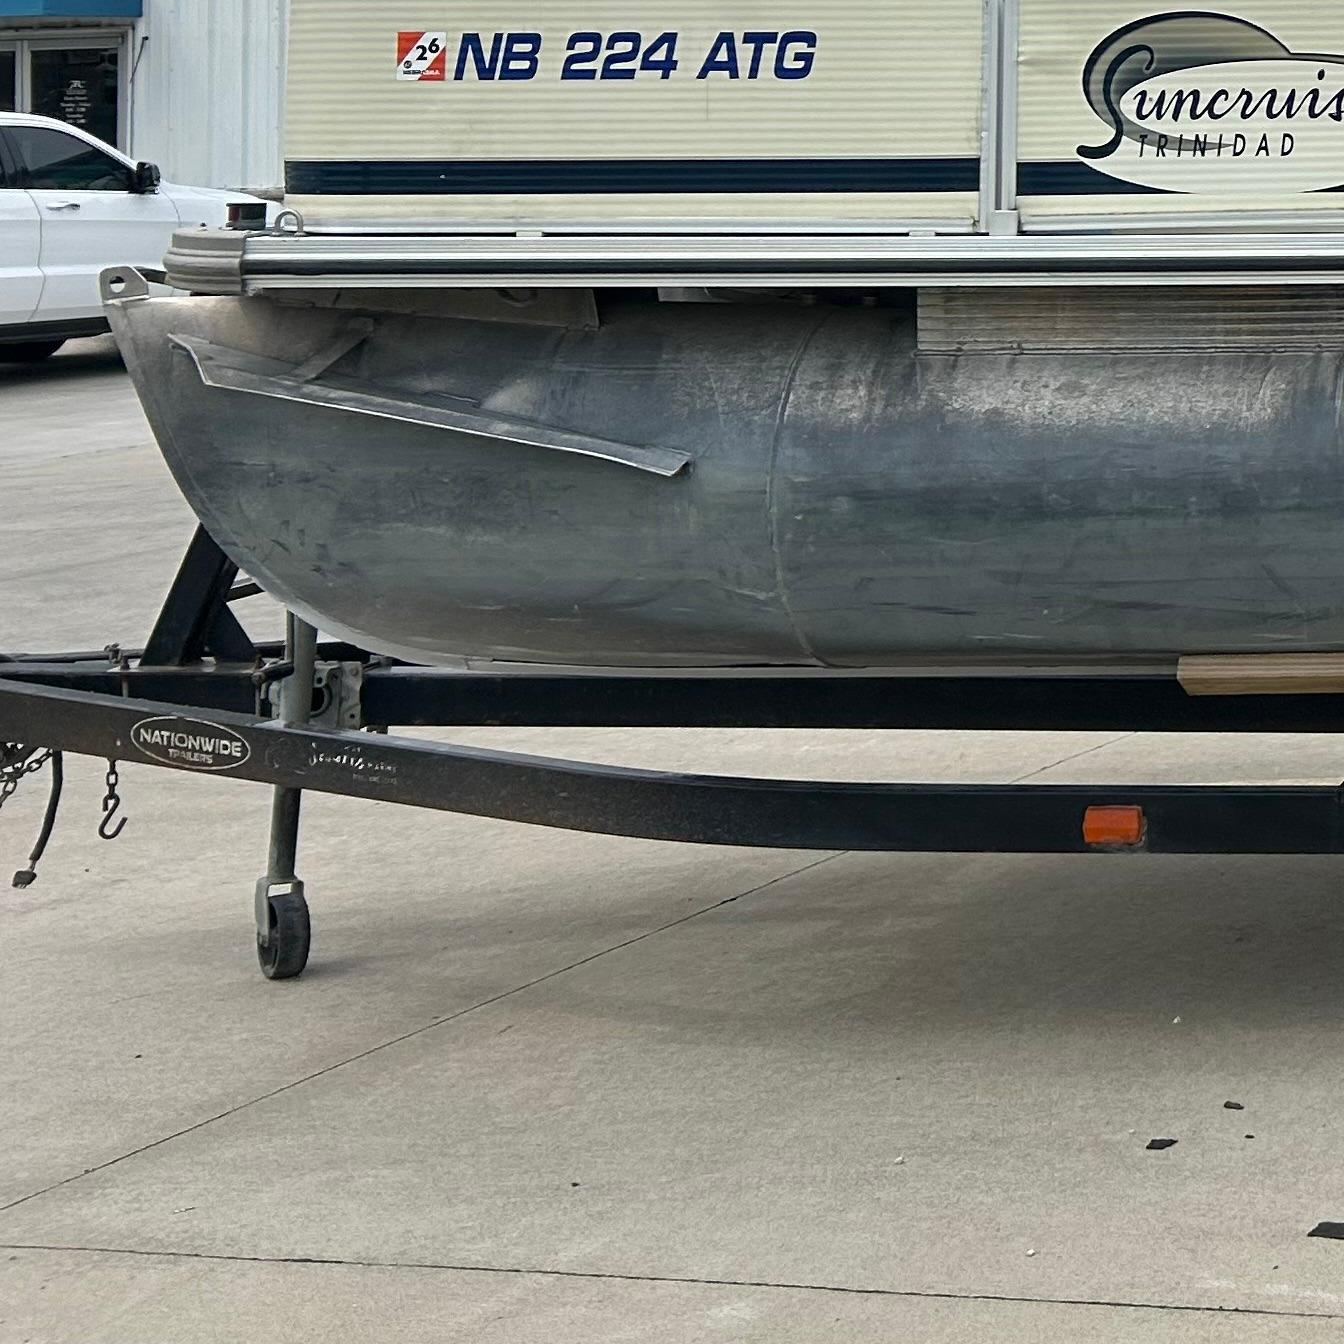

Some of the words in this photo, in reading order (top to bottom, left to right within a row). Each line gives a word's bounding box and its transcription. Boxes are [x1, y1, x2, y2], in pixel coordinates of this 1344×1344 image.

[415, 37, 440, 61] 26
[453, 32, 542, 81] NB
[561, 32, 679, 81] 224
[697, 31, 817, 81] ATG
[1138, 133, 1295, 158] TRINIDAD
[139, 728, 242, 757] NATIONWIDE
[168, 748, 213, 764] TRAILERS
